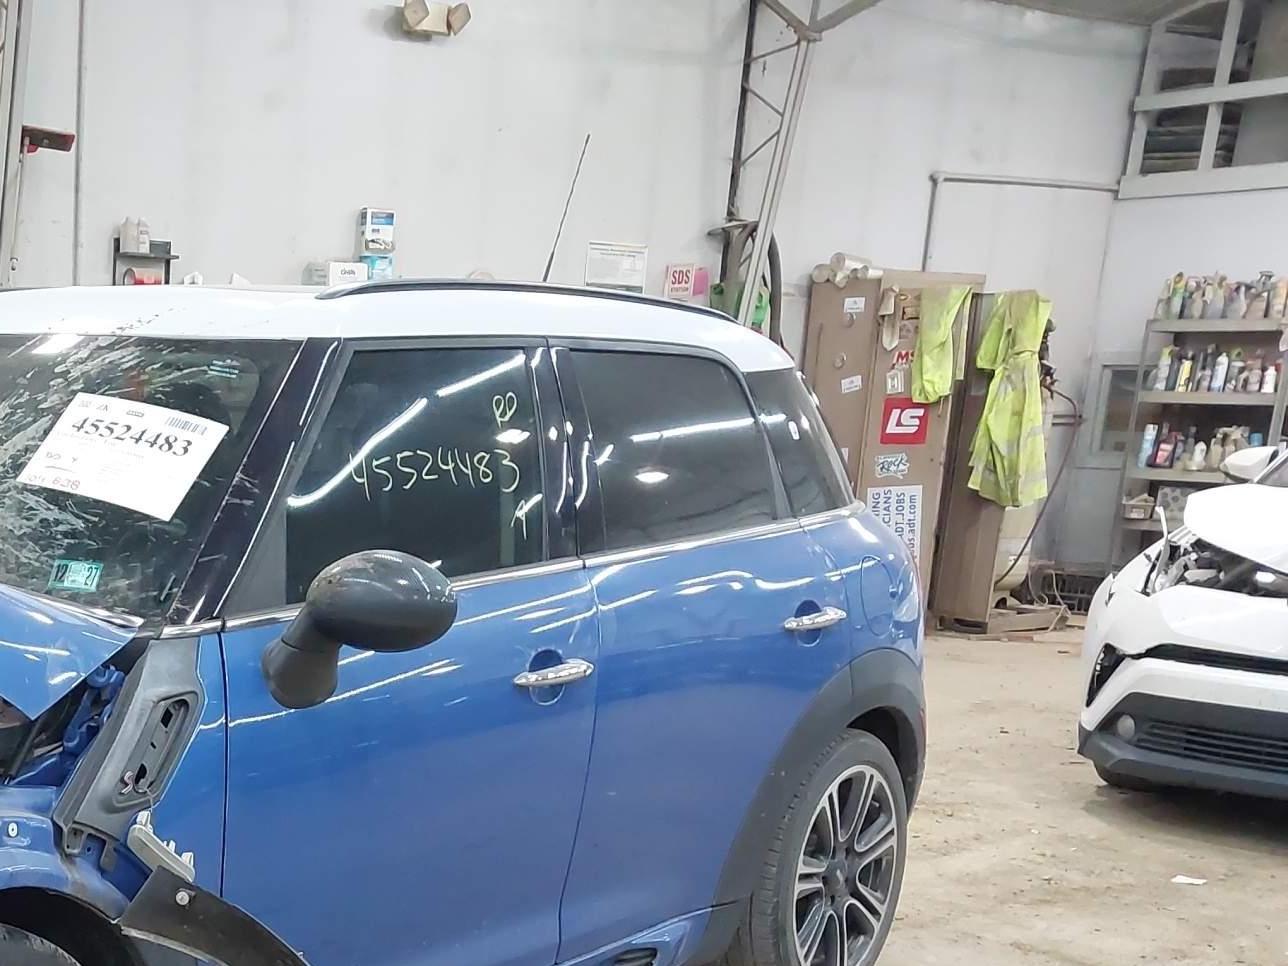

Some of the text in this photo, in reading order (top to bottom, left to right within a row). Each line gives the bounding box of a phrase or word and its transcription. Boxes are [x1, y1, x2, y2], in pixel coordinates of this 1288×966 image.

[671, 269, 690, 285] SDS
[885, 408, 925, 434] LS
[72, 417, 193, 457] 45524483
[349, 446, 520, 502] 45524483
[53, 563, 69, 583] 12
[83, 566, 99, 588] 27
